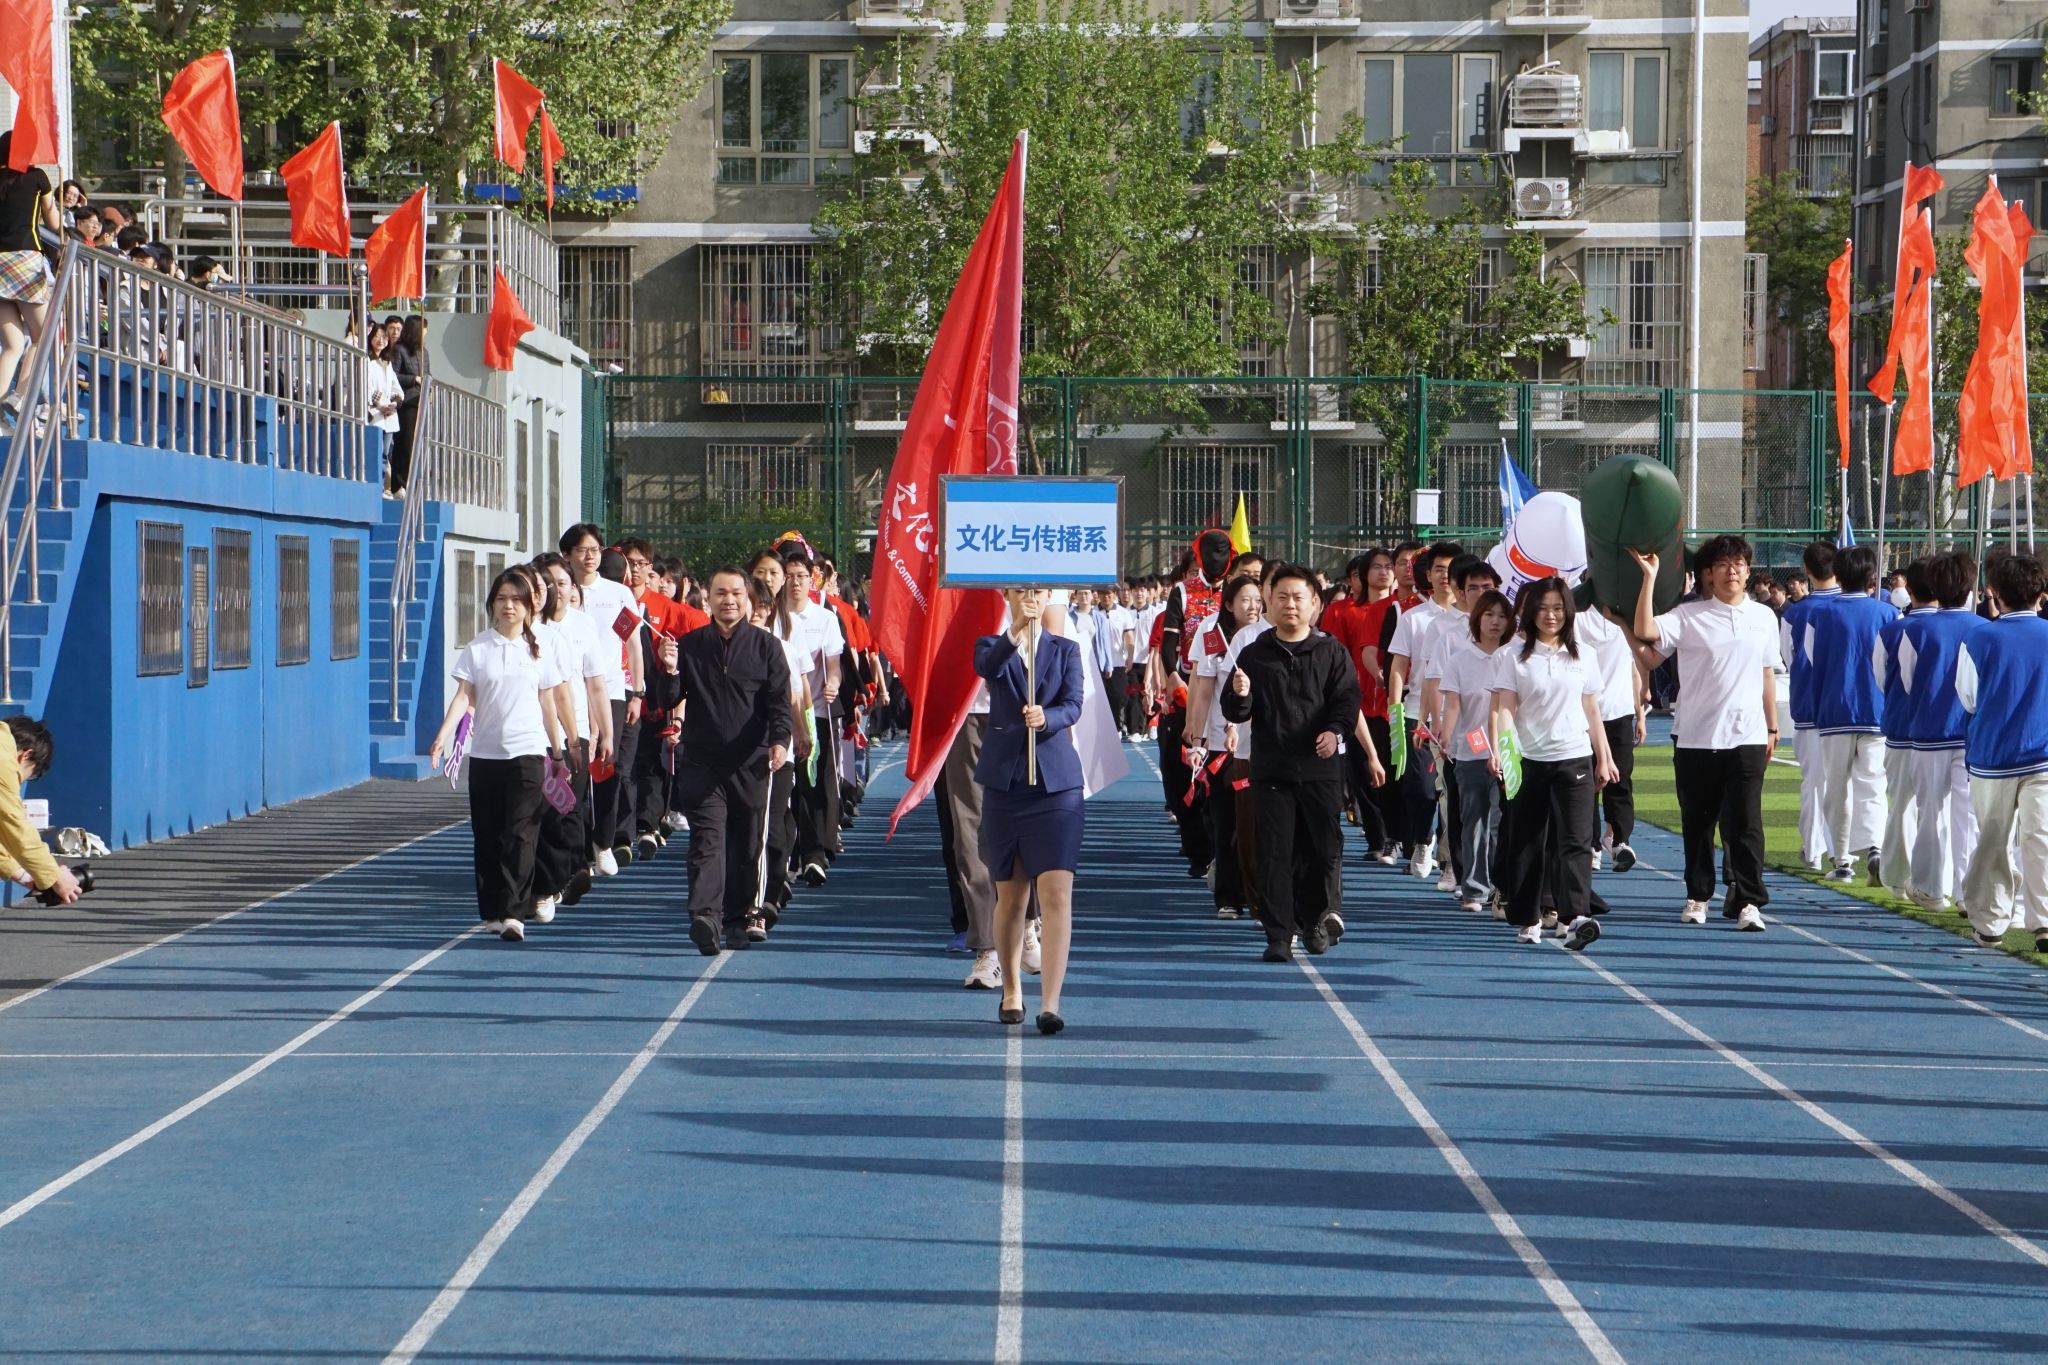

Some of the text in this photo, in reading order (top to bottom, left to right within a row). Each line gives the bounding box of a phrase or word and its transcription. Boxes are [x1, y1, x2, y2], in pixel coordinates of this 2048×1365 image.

[956, 523, 1108, 553] 文化与传播系
